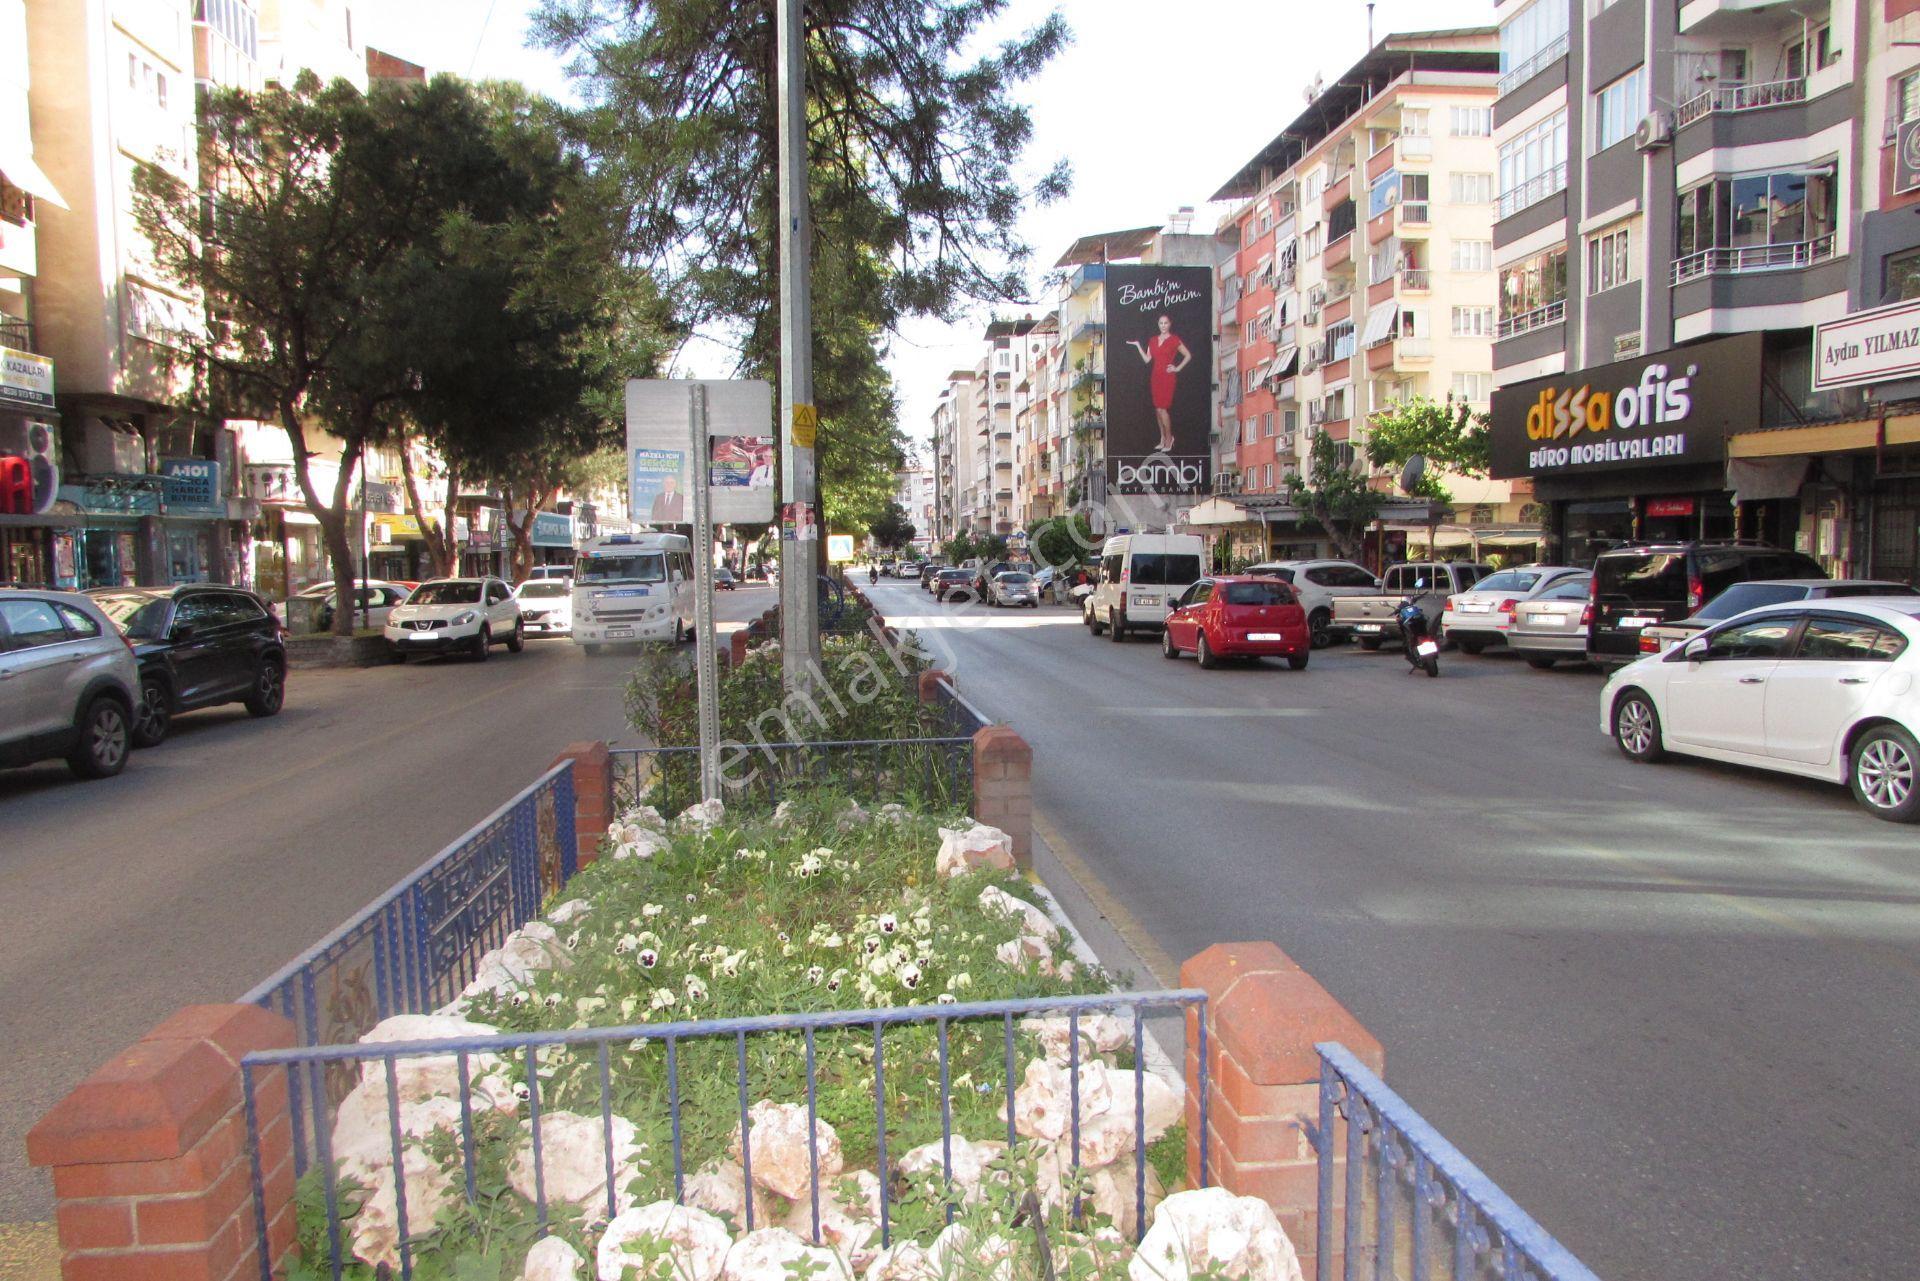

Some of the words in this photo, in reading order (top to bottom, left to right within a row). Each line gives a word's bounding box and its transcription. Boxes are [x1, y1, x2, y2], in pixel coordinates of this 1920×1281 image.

[1118, 279, 1181, 305] Bambi'm
[1140, 299, 1161, 312] var
[1164, 289, 1201, 307] benim.
[1825, 342, 1859, 366] Aydın
[1864, 327, 1919, 355] YILMAZ
[7, 360, 45, 377] KAZALARI
[1526, 383, 1612, 441] dissa
[1614, 363, 1692, 429] ofis
[1529, 447, 1568, 469] BÜRO
[1571, 433, 1686, 465] MOBİLYALARI
[1118, 460, 1202, 484] bambi
